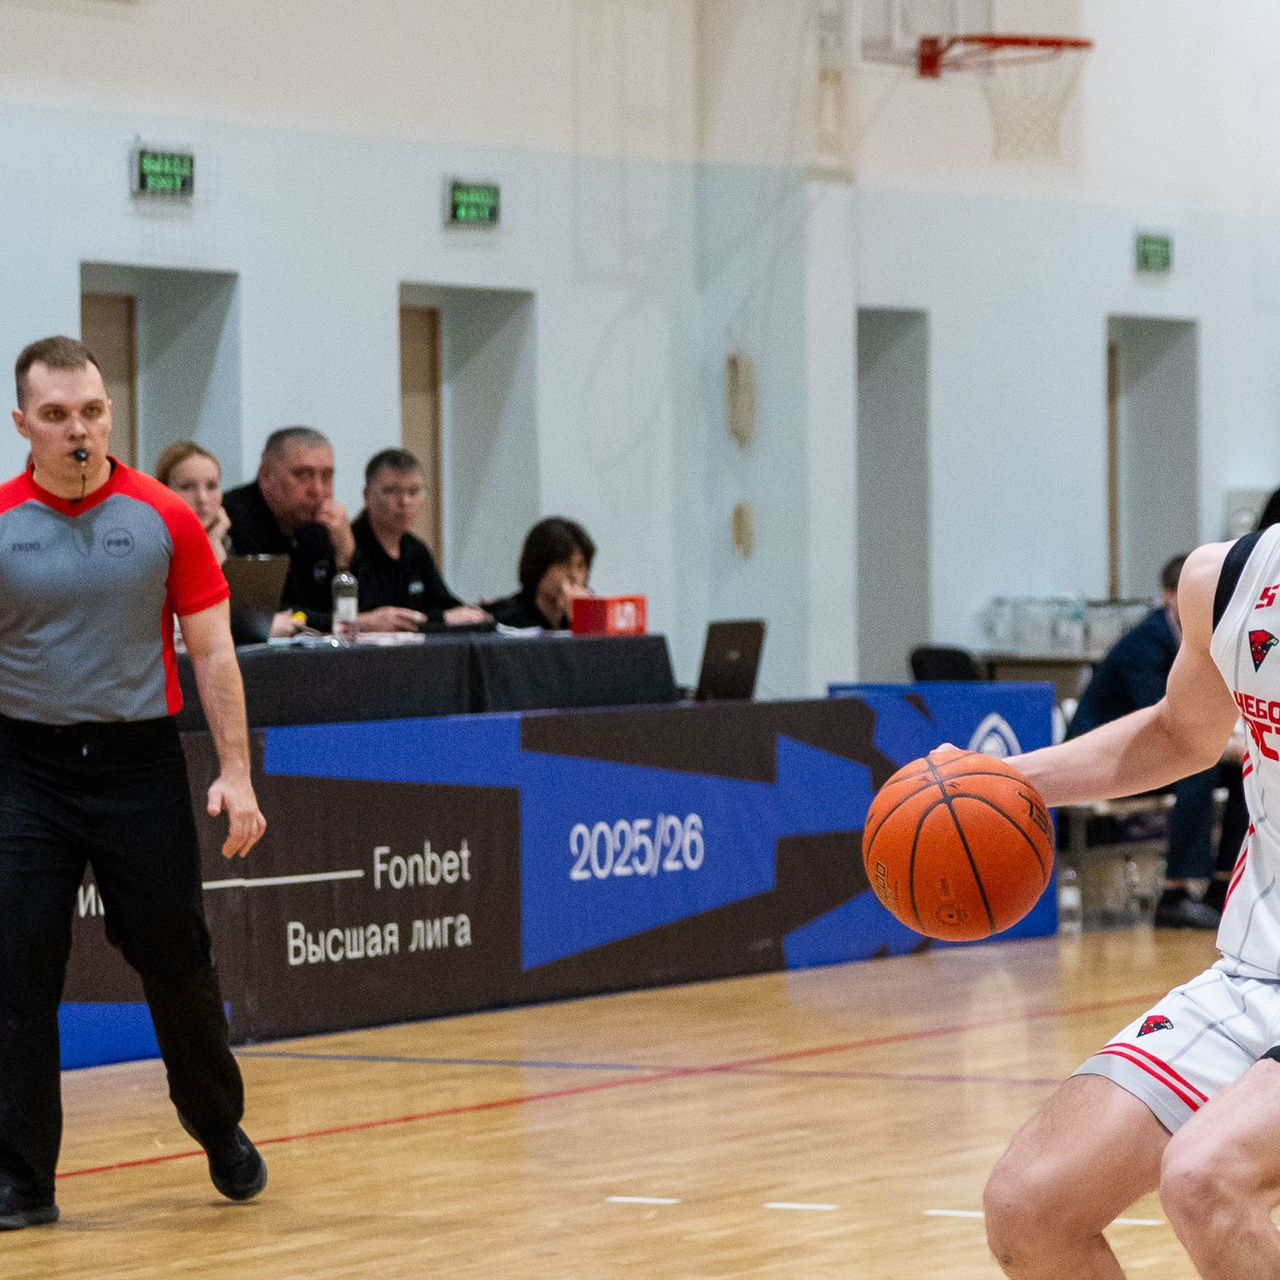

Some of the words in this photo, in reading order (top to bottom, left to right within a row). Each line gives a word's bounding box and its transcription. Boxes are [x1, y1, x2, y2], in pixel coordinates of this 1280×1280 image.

[373, 838, 471, 890] Fonbet
[569, 812, 705, 882] 2025/26
[287, 921, 400, 966] Высшая
[408, 913, 472, 953] лига
